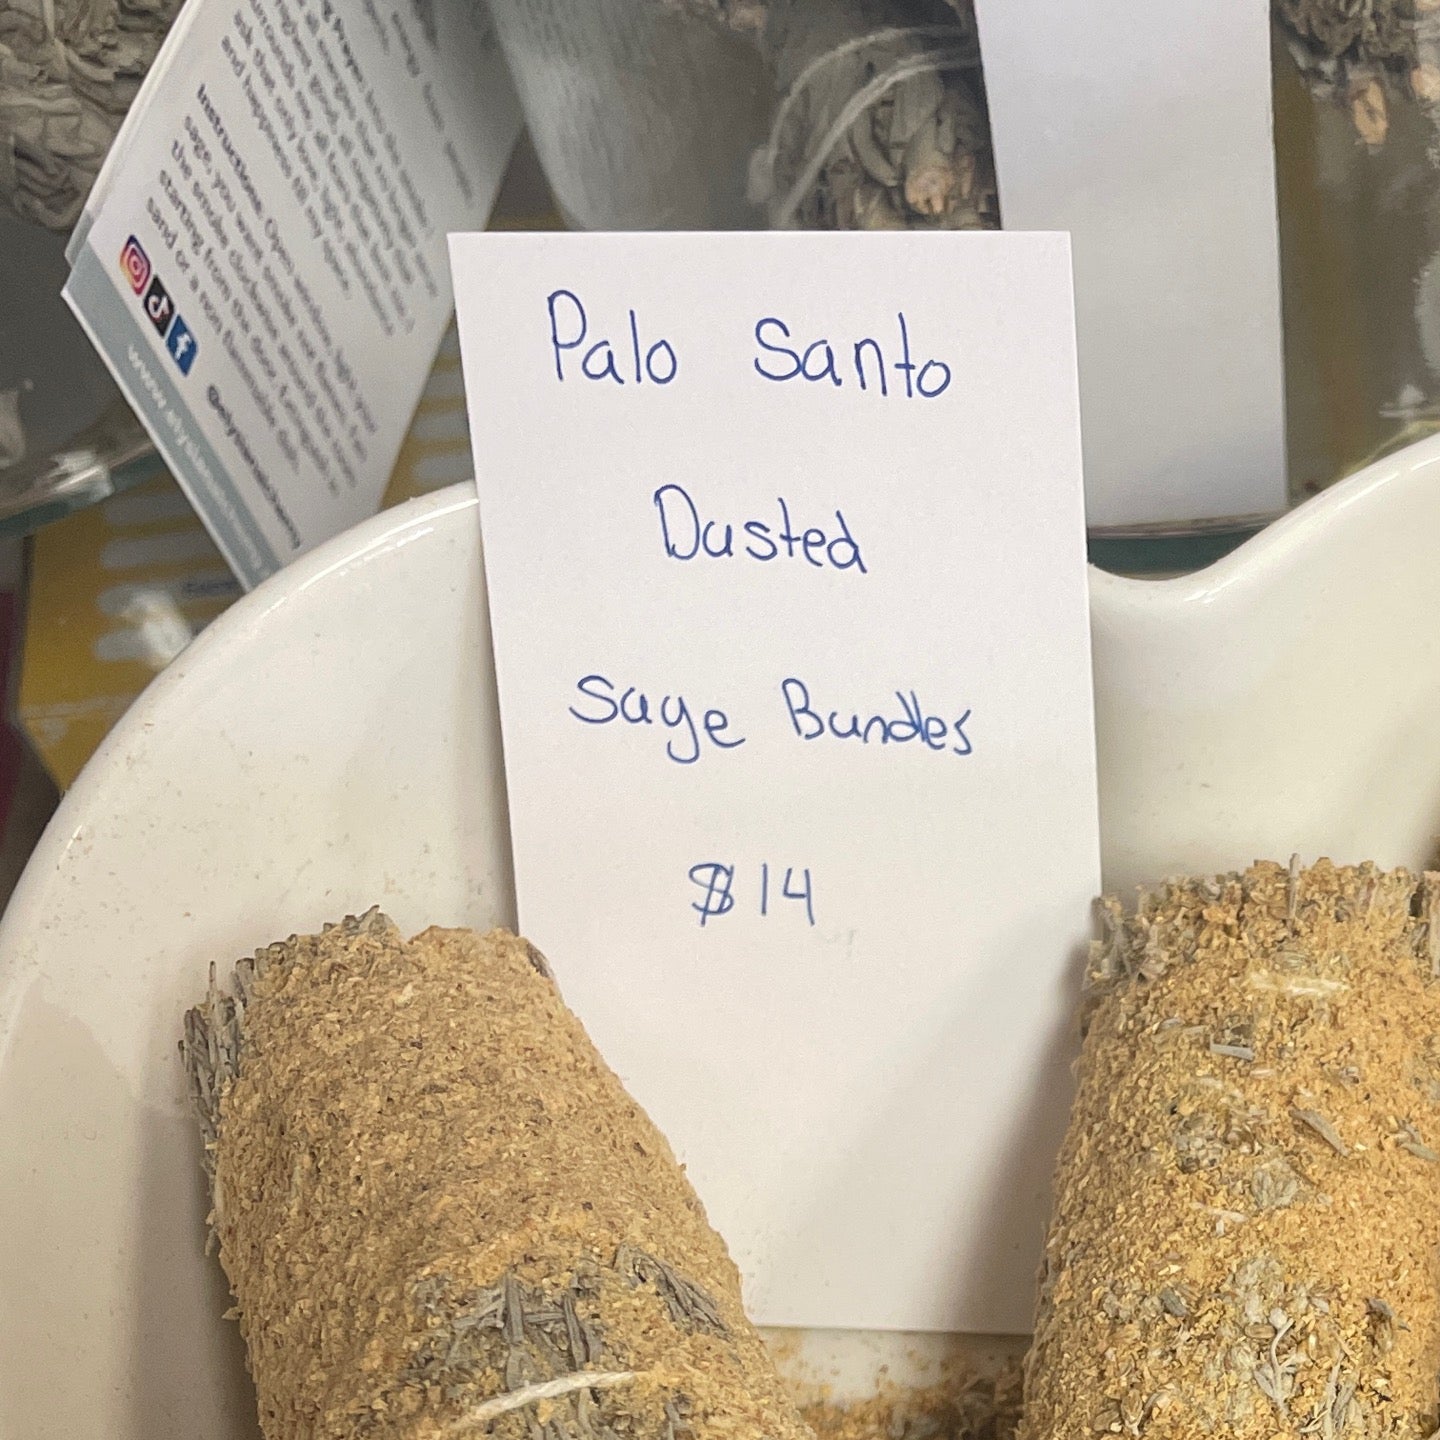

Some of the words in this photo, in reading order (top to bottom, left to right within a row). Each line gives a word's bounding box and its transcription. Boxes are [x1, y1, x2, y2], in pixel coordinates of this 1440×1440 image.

[146, 197, 178, 250] sand
[175, 249, 191, 274] or
[159, 170, 204, 255] starting
[547, 290, 677, 384] Palo
[754, 311, 951, 398] Santo
[654, 484, 867, 573] Dusted
[781, 678, 973, 756] Bundles
[688, 862, 816, 926] $14
